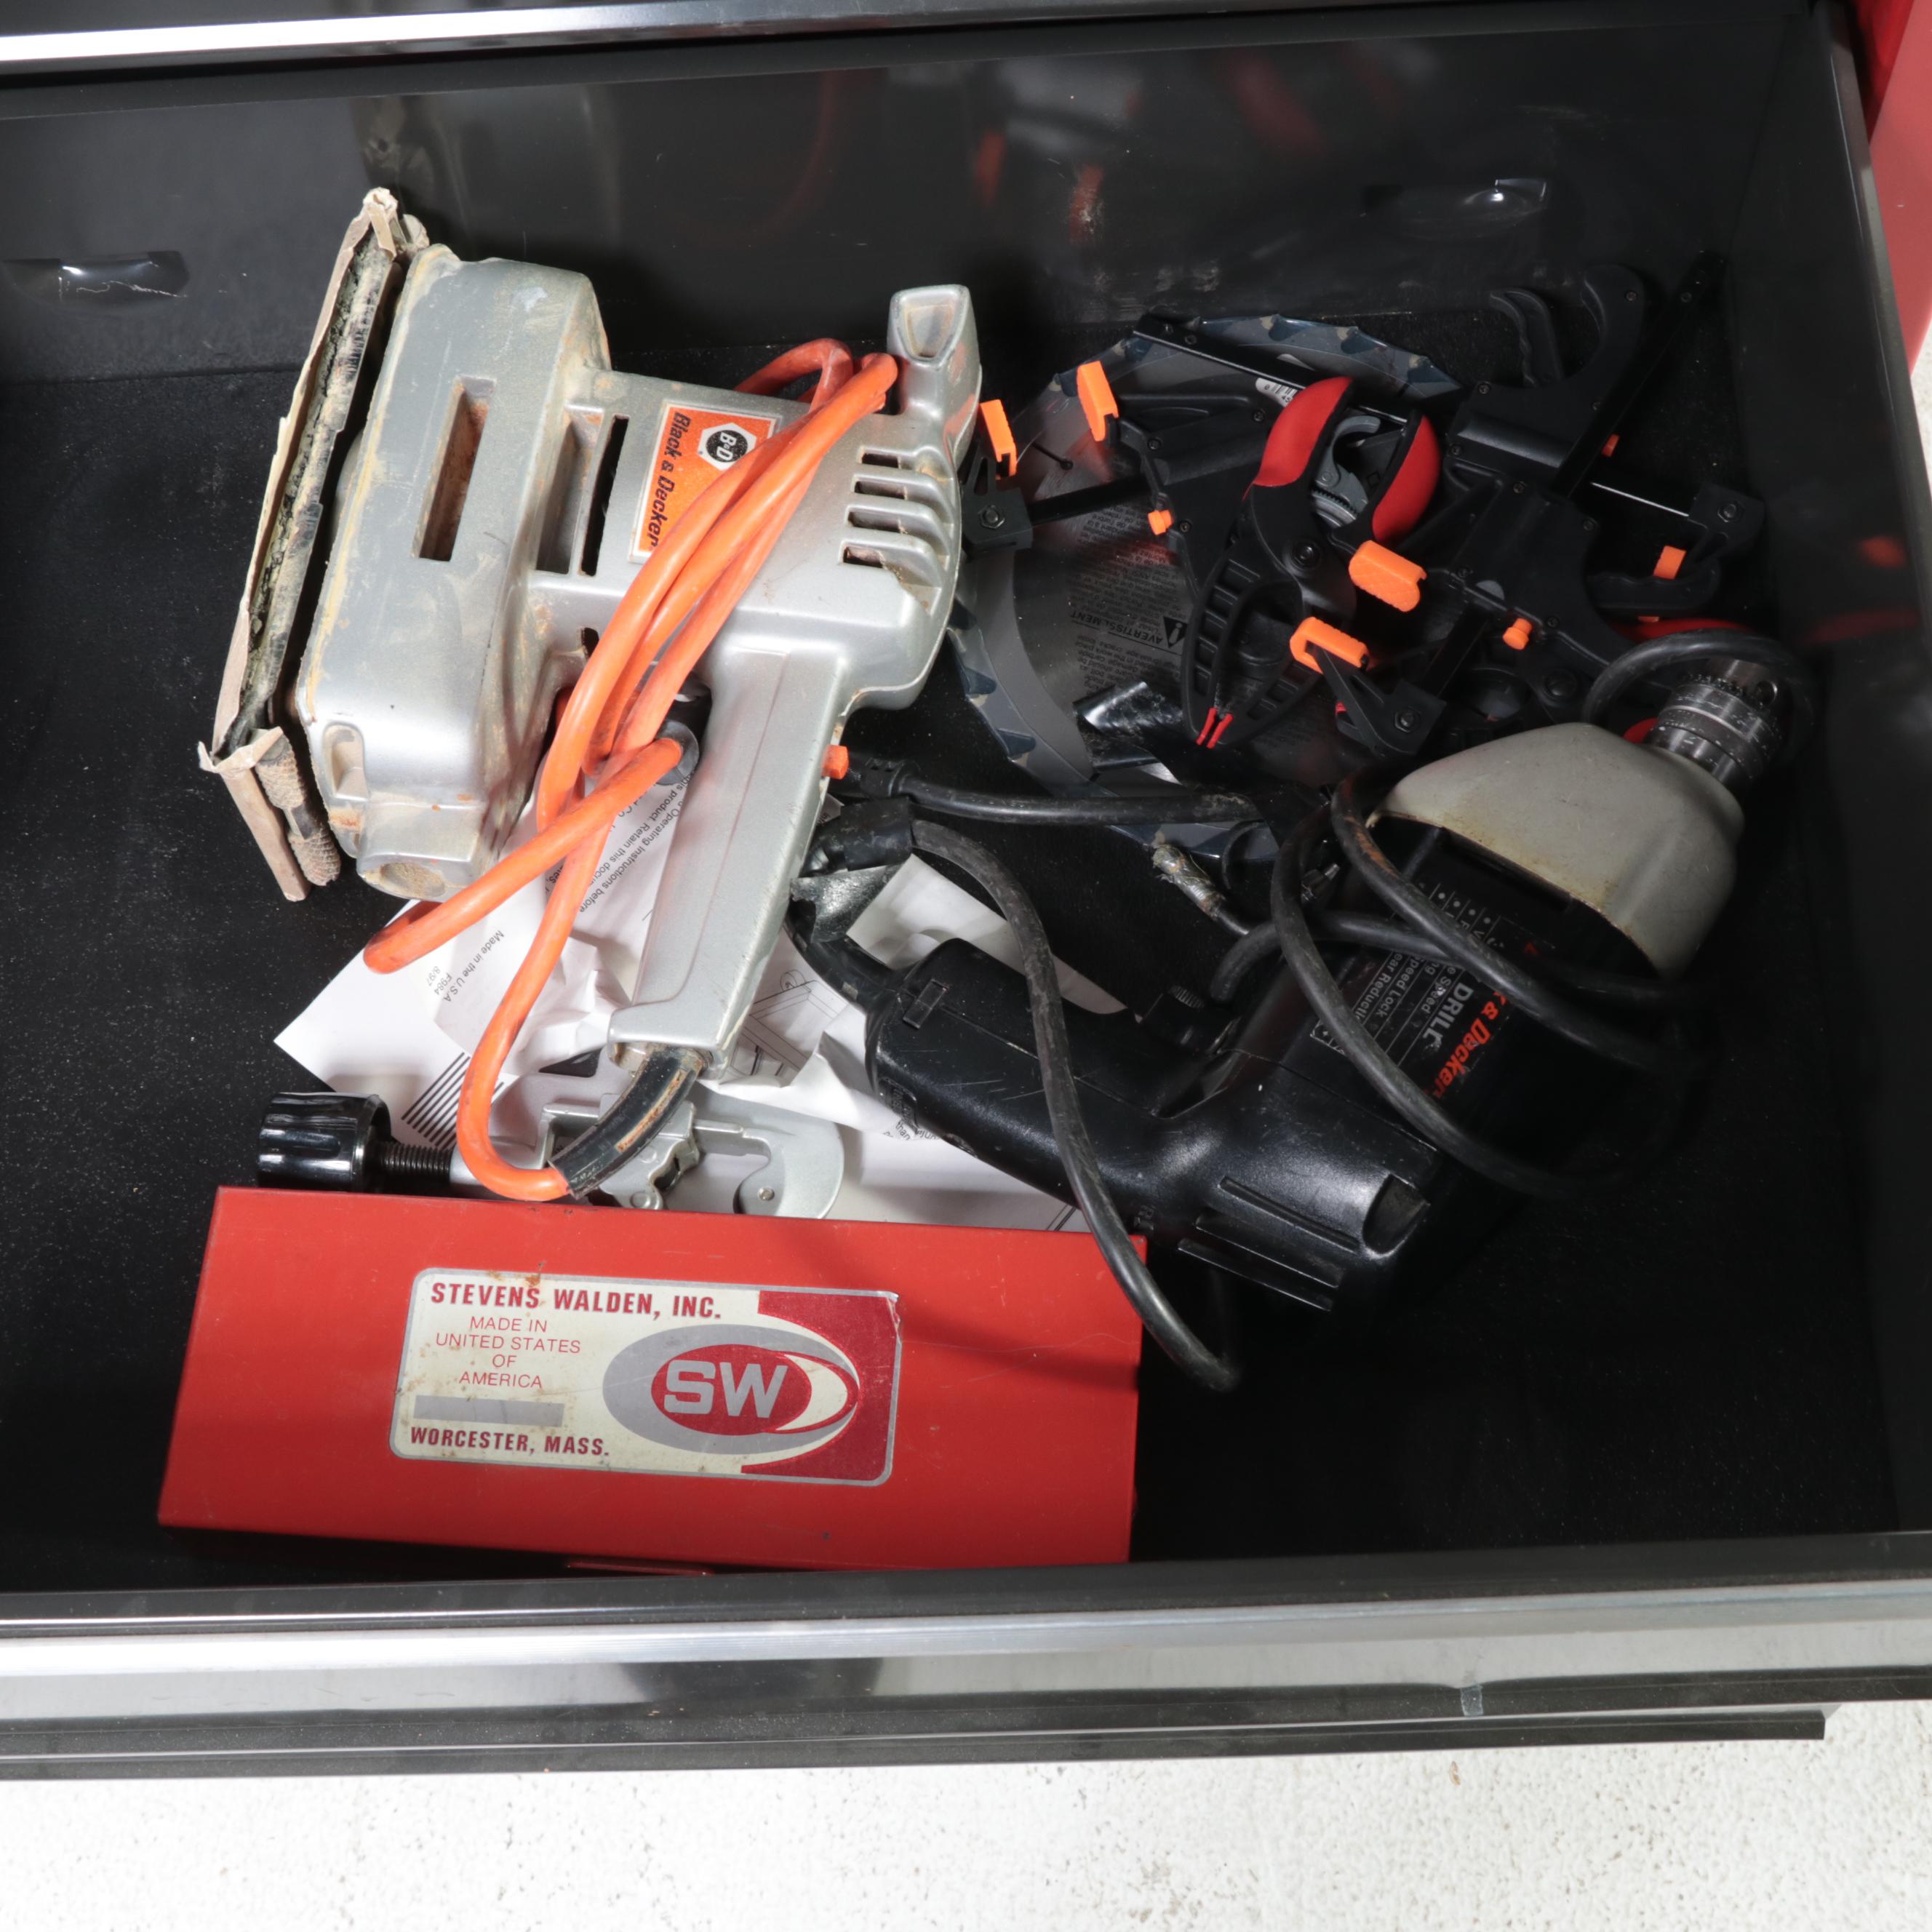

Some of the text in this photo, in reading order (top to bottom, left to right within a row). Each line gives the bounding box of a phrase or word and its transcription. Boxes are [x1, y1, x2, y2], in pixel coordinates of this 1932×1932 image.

[647, 412, 692, 548] Black & Decker
[624, 822, 650, 849] Retain
[580, 808, 679, 912] Operating Instructions before
[609, 847, 626, 863] this
[481, 930, 505, 954] Made
[462, 962, 476, 977] the
[473, 953, 484, 963] in
[1386, 953, 1403, 973] ear
[1376, 989, 1402, 1017] Lock
[1433, 1018, 1490, 1099] Decker
[431, 1282, 721, 1320] STEVENS WALDEN, INC.
[469, 1316, 548, 1333] MADE IN
[436, 1333, 580, 1354] UNITED STATES
[492, 1354, 516, 1368] OF
[459, 1371, 543, 1389] AMERICA
[663, 1360, 788, 1418] SW
[411, 1426, 609, 1456] WORCESTER, MASS.
